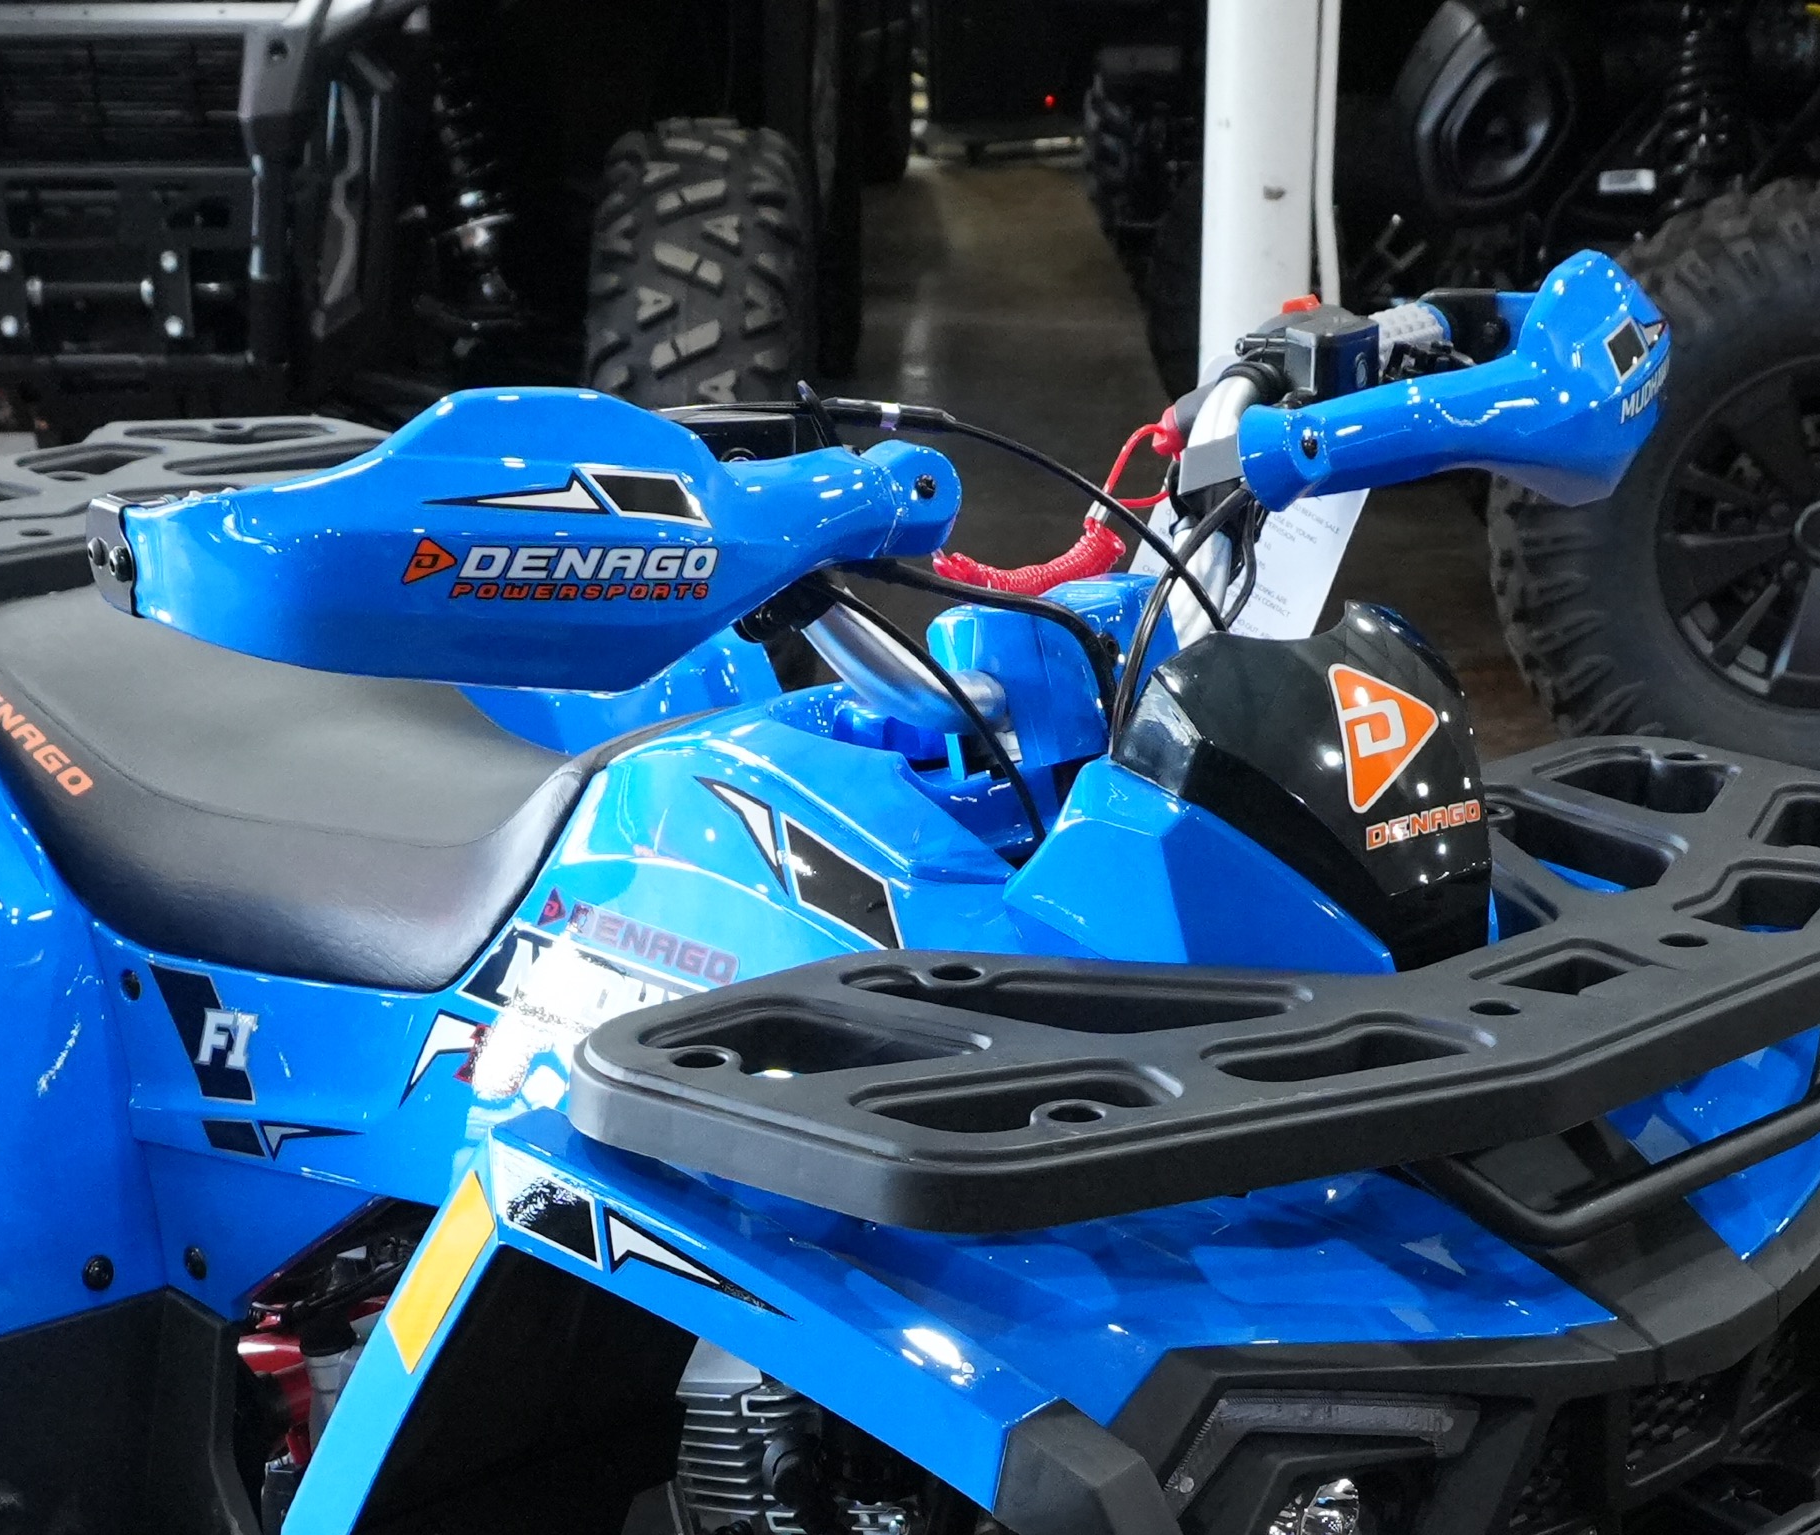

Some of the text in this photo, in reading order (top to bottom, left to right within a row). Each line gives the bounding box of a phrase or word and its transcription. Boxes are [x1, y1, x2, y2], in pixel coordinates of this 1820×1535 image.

[1265, 520, 1297, 542] PERVISION
[456, 546, 720, 580] DENAGO
[449, 582, 710, 601] POWERSPORTS
[1366, 800, 1481, 850] DENAGO
[567, 901, 739, 985] DENAGO
[194, 1007, 259, 1072] FI
